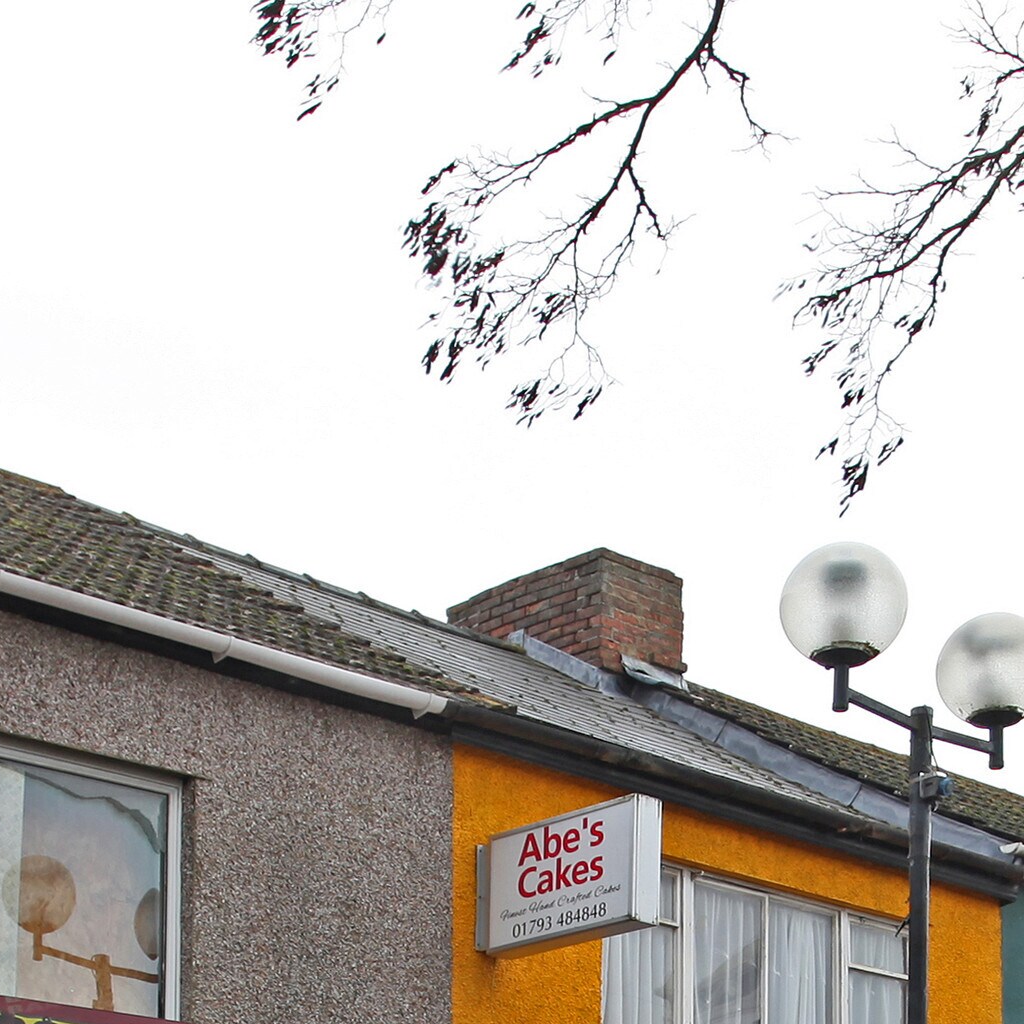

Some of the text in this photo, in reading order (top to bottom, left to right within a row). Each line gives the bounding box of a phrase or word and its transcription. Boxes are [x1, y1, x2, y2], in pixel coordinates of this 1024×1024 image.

[518, 817, 604, 866] Abe's
[518, 856, 604, 898] Cakes
[512, 902, 606, 938] 01793 484848
